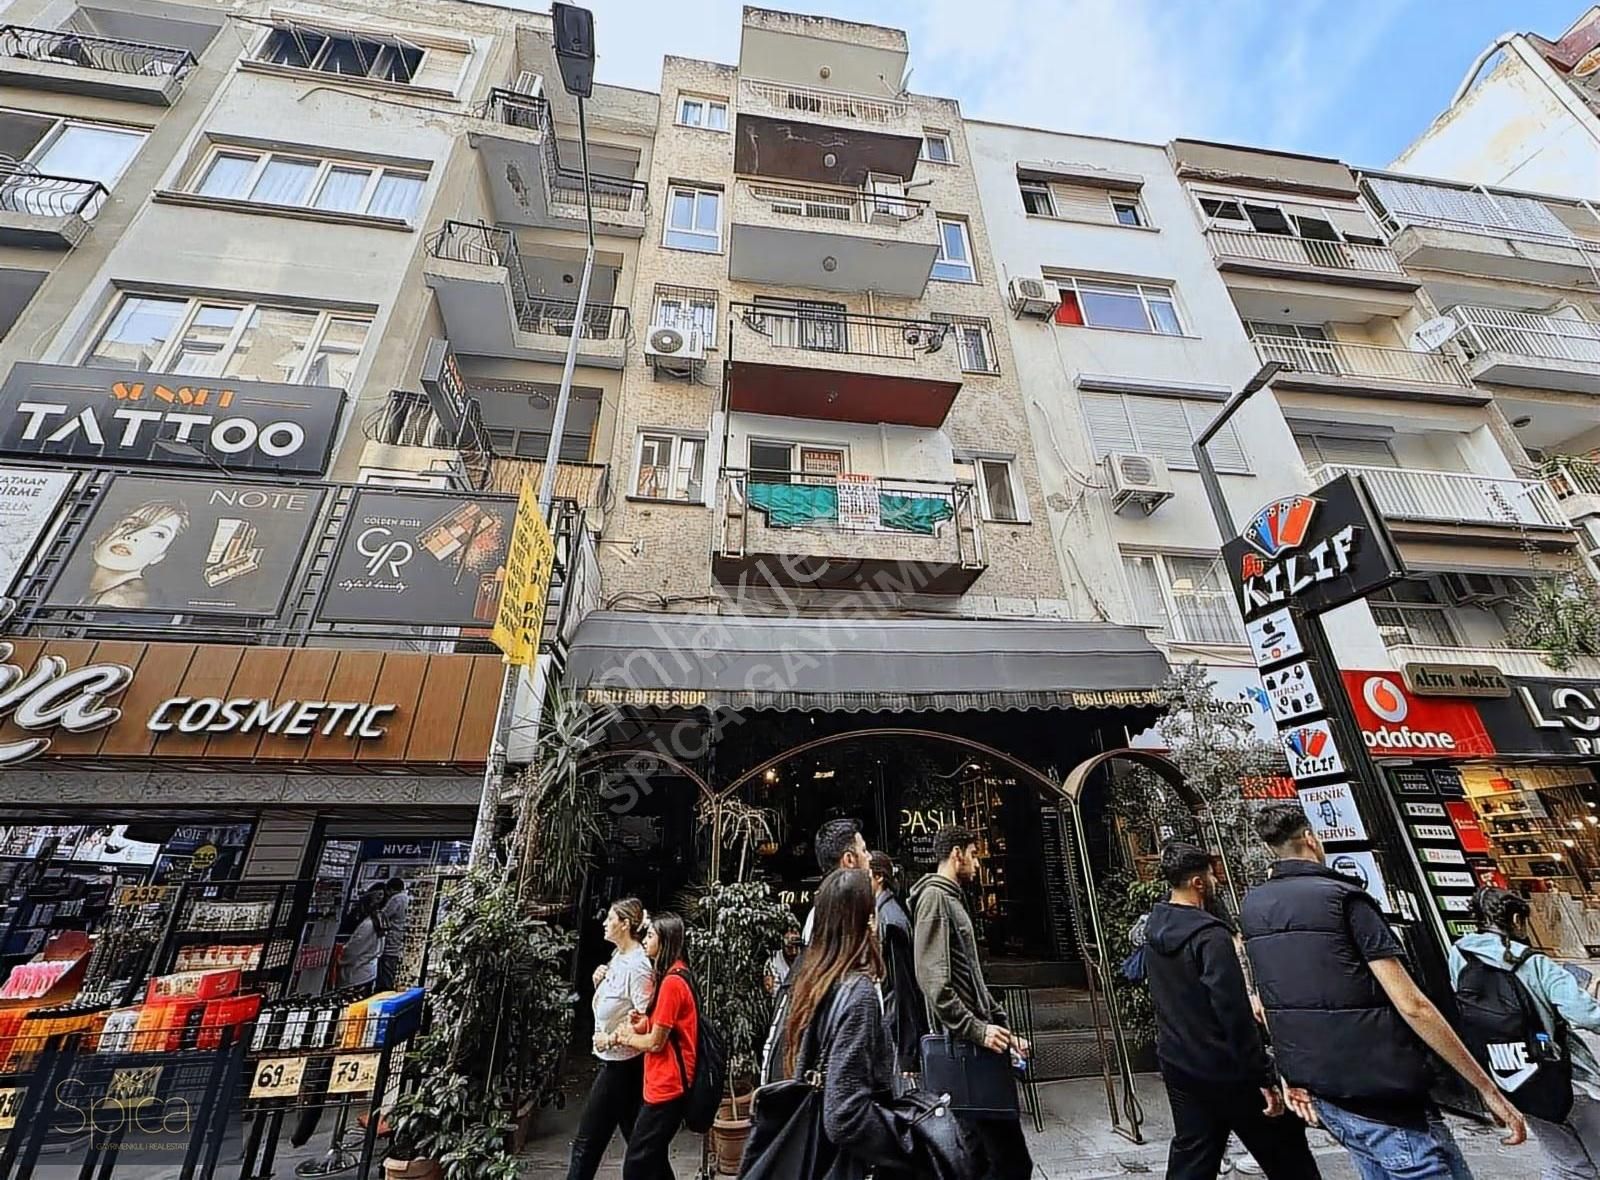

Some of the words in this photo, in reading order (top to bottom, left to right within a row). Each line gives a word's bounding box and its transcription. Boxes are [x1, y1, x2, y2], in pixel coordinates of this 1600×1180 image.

[17, 402, 304, 457] TATTOO
[208, 489, 305, 511] NOTE
[1243, 525, 1354, 616] KILIF
[625, 690, 670, 704] COFFEE
[671, 690, 706, 704] SHOP
[147, 697, 400, 738] COSMETIC
[1362, 726, 1456, 749] odafone
[1296, 757, 1335, 777] KILIF
[1304, 787, 1345, 802] TEKNİK
[383, 844, 421, 855] NIVEA
[1486, 1042, 1529, 1070] NIKE
